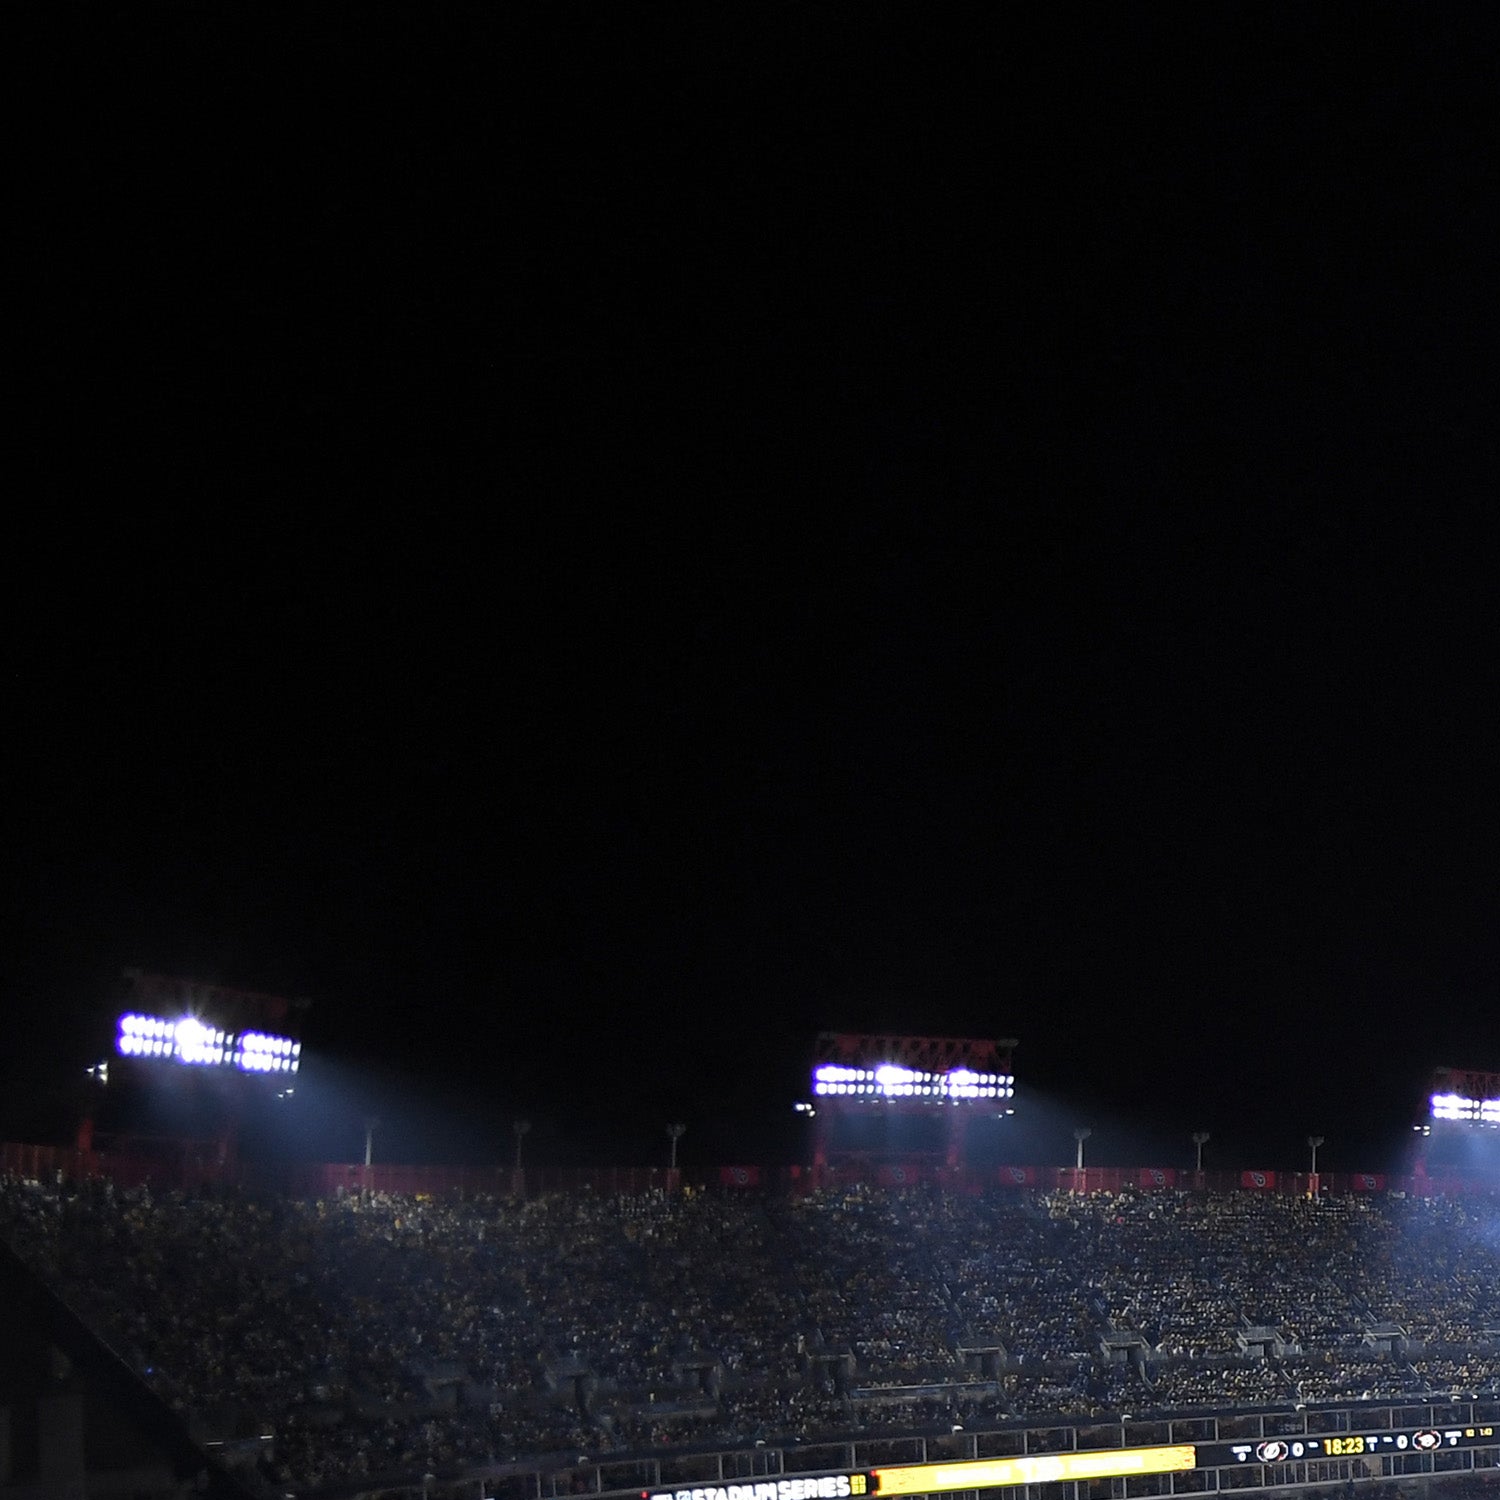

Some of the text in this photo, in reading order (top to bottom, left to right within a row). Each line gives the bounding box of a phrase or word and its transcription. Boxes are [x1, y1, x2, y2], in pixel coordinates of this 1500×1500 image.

[1292, 1437, 1364, 1457] 0 18:23
[1397, 1435, 1407, 1448] 0
